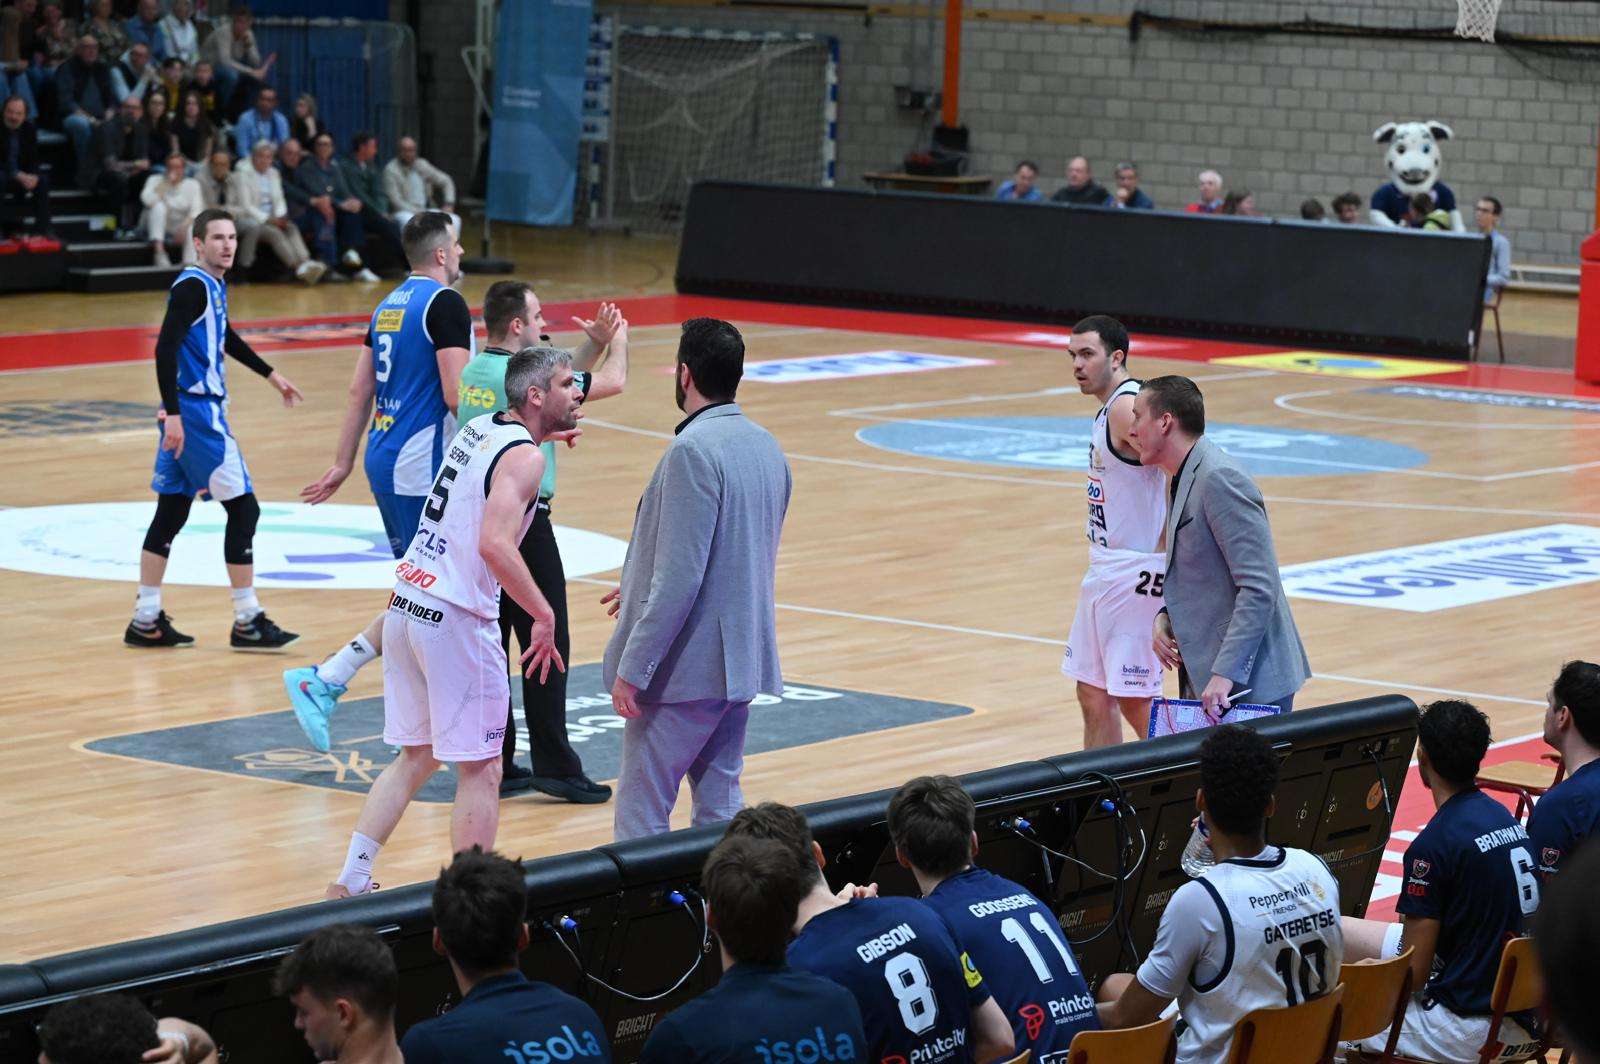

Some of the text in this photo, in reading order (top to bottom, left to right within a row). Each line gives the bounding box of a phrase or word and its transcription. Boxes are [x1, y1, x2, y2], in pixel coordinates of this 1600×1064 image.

[376, 333, 393, 382] 3
[424, 464, 458, 524] 5
[1135, 570, 1164, 598] 25
[392, 595, 405, 610] DB
[407, 603, 444, 624] VIDEO
[1249, 882, 1311, 909] PepperMill
[1510, 846, 1541, 917] 6
[968, 893, 1038, 918] GOOSSENS
[1059, 910, 1086, 928] RIGHT
[1272, 904, 1298, 916] FRIENDS
[856, 923, 917, 964] GIBSON
[1264, 908, 1335, 944] GATERETSE
[1001, 911, 1080, 984] 11
[1275, 939, 1329, 1008] 10
[884, 951, 939, 1035] 8
[615, 1012, 657, 1038] BRIGHT
[503, 1025, 602, 1064] isola
[755, 1026, 852, 1064] isola
[909, 1028, 967, 1064] Printcity
